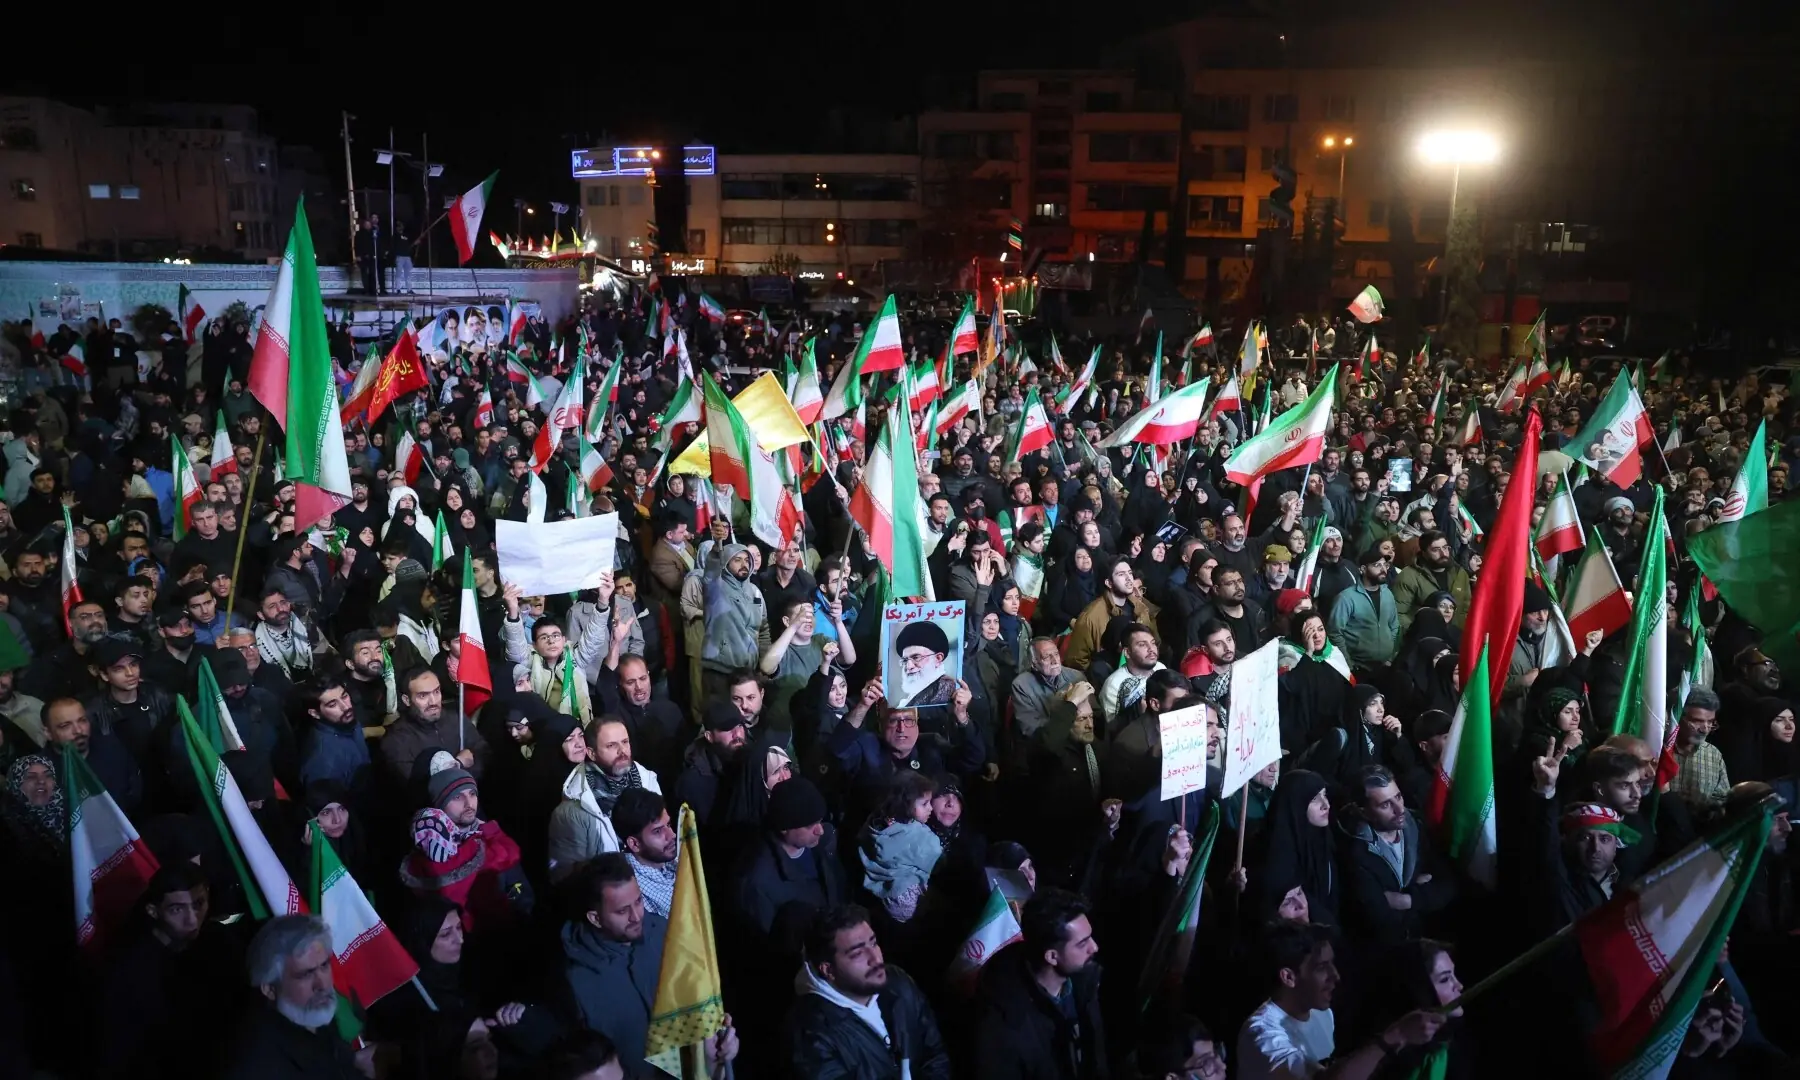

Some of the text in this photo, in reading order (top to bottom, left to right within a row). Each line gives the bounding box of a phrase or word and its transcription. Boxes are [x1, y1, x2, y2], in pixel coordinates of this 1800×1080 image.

[688, 259, 704, 274] بانک
[886, 605, 963, 622] مرگ بر آمریکا
